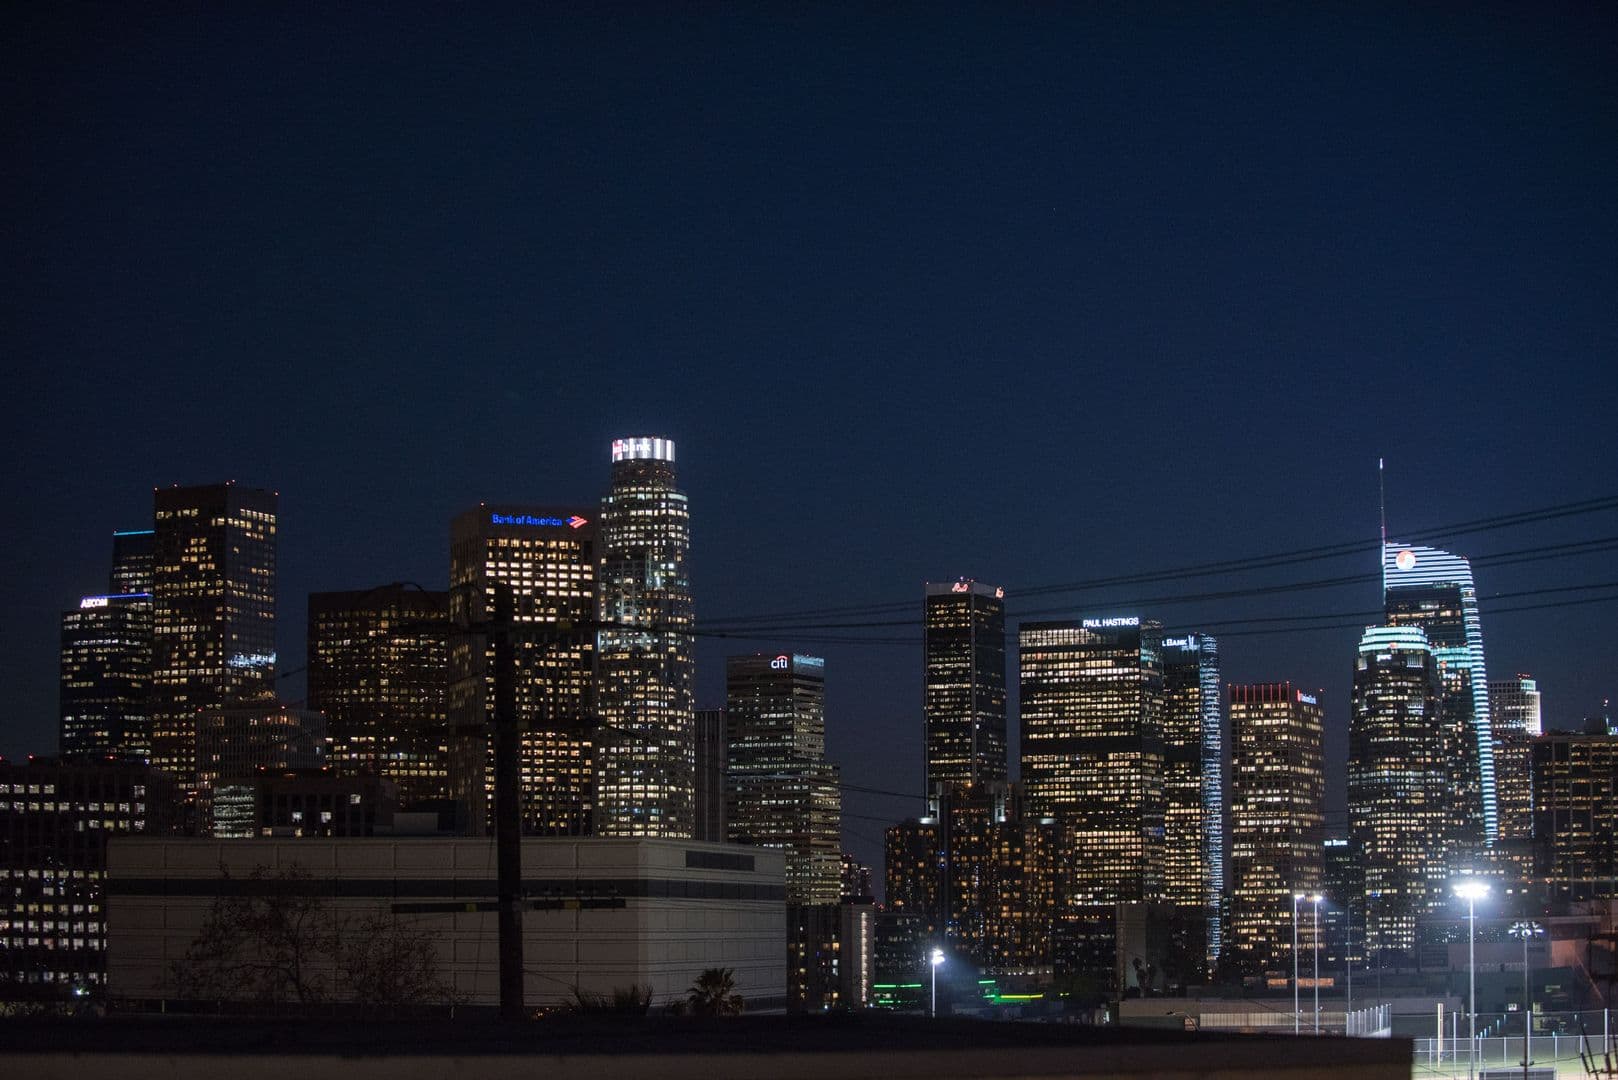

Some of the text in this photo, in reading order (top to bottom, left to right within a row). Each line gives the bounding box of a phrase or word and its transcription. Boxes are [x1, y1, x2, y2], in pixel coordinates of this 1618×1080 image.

[491, 513, 563, 527] Bank of America
[1082, 617, 1140, 629] PAUL HASTINGS
[770, 657, 788, 669] citi
